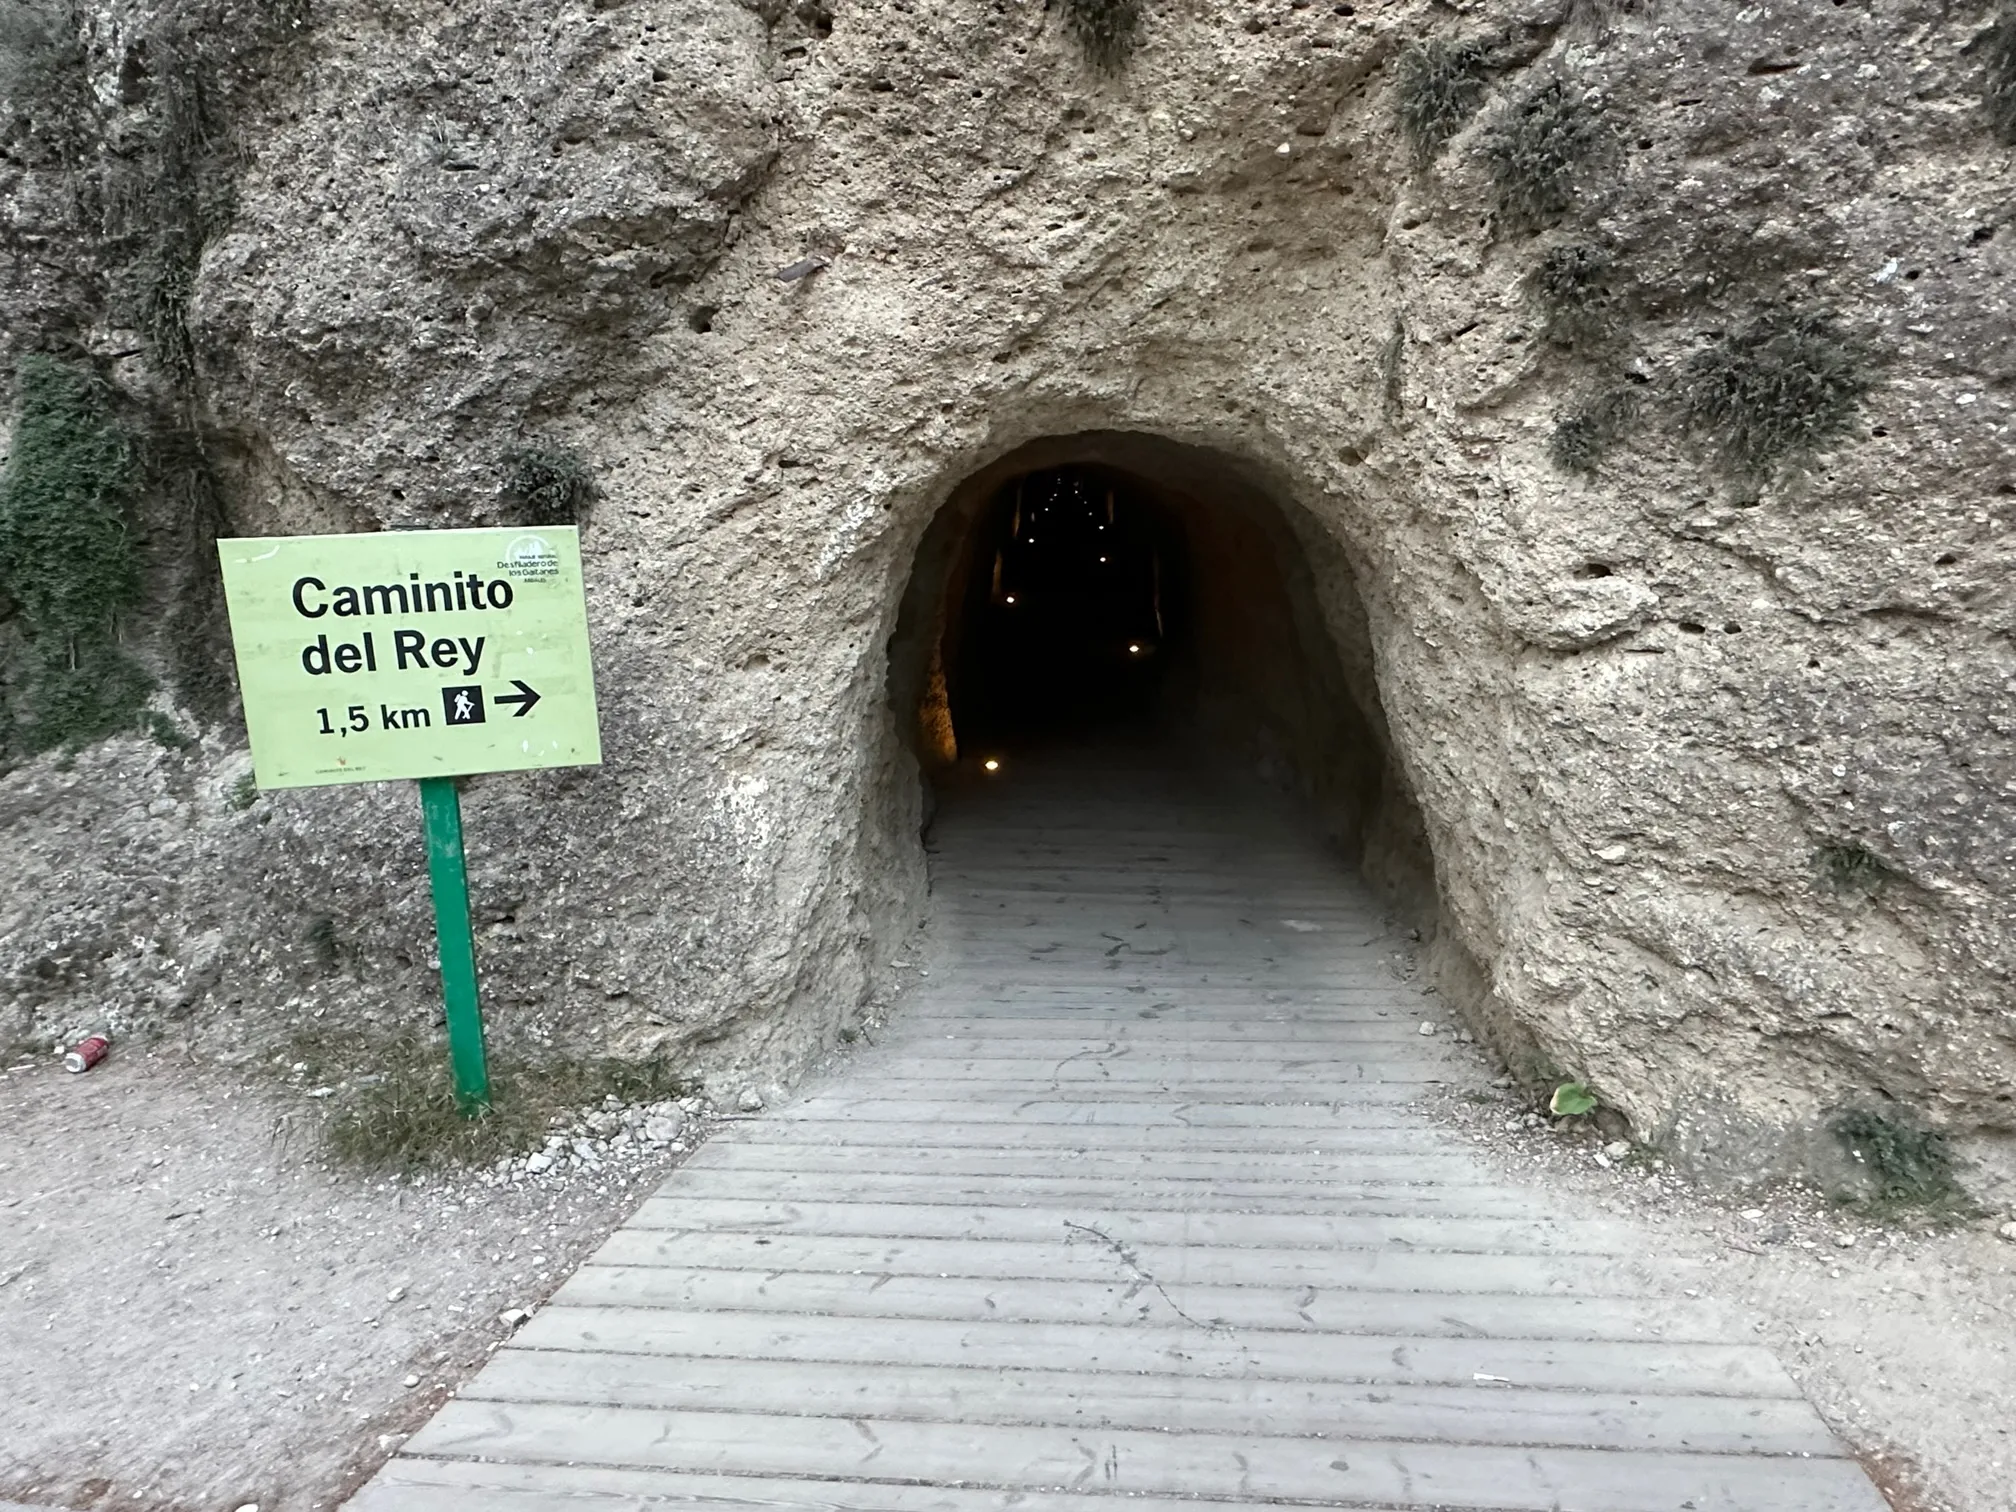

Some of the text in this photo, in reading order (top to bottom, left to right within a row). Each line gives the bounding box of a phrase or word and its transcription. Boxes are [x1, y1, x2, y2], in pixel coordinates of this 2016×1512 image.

[293, 571, 513, 618] Caminito
[302, 630, 486, 675] del Rey
[317, 705, 431, 737] 1,5 km
